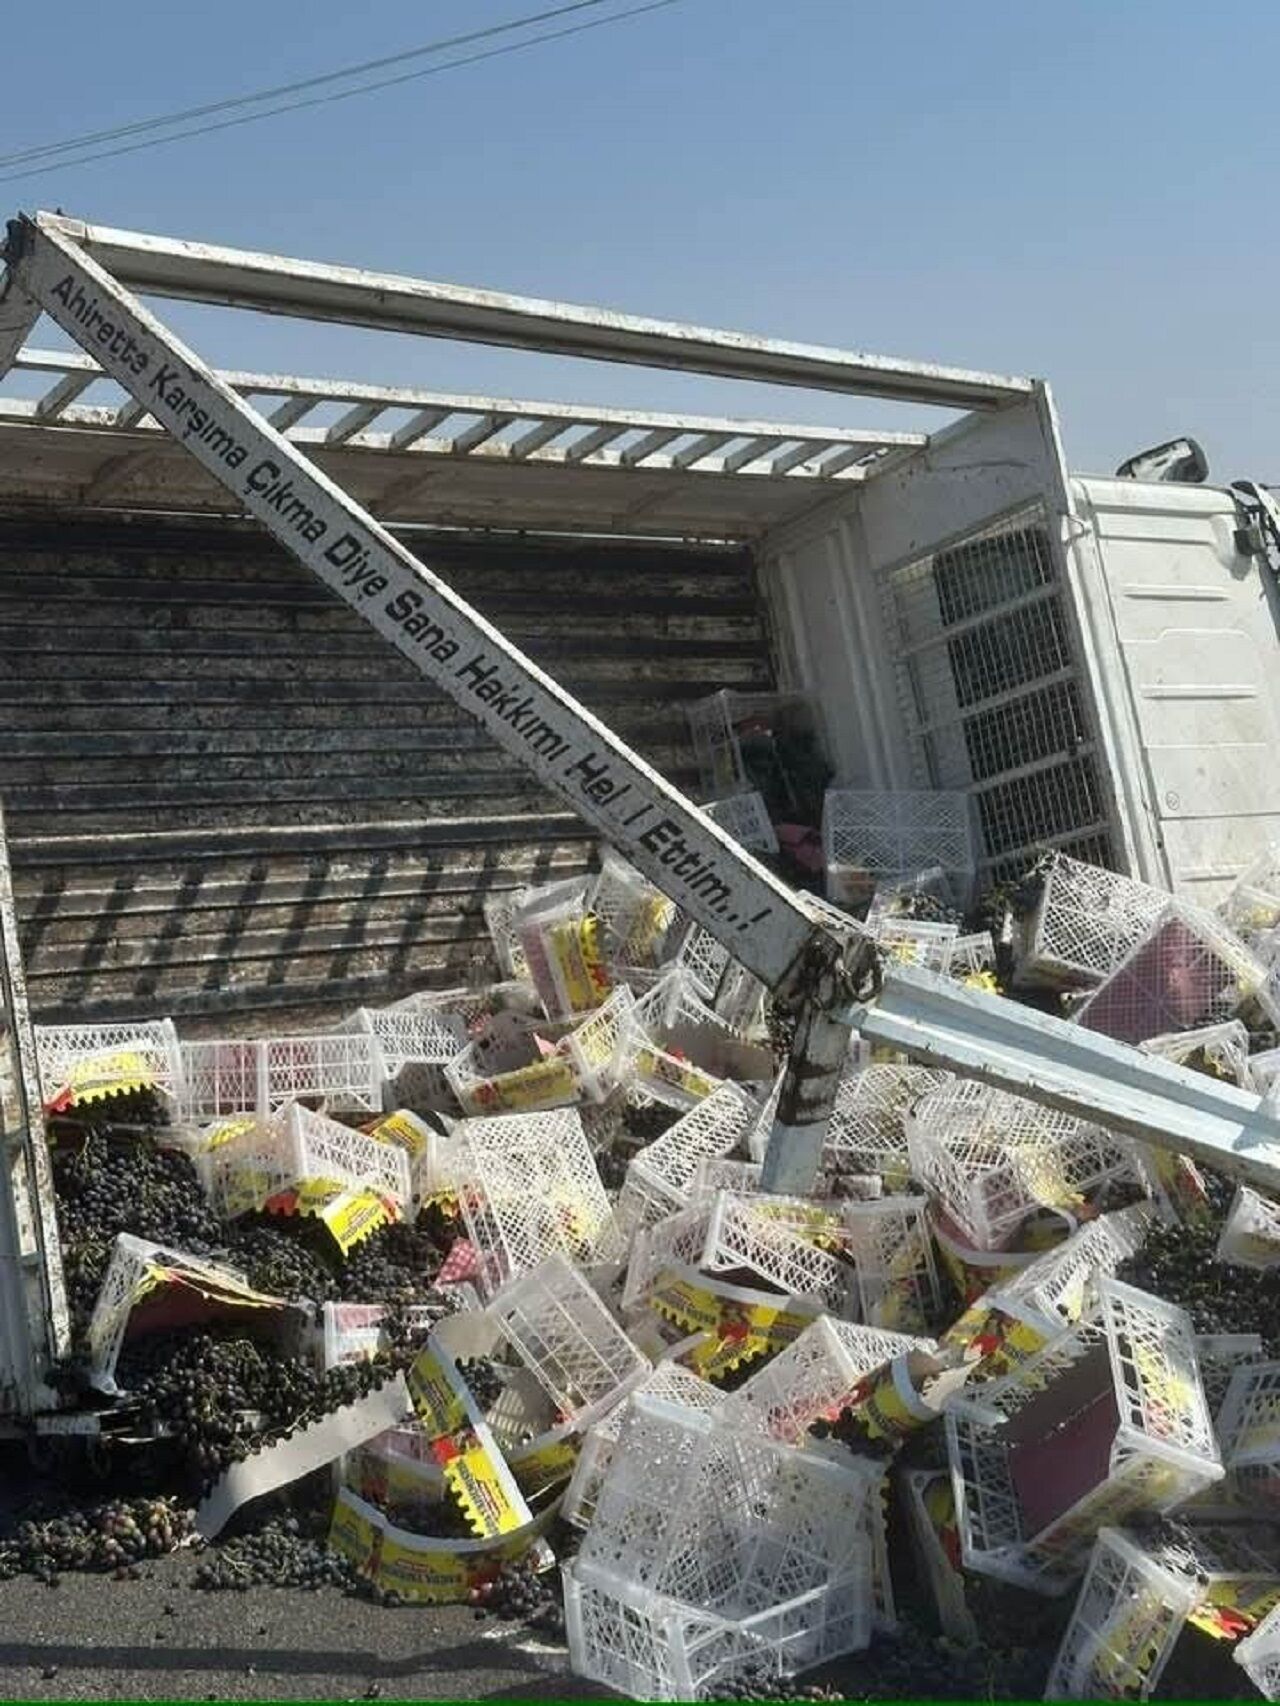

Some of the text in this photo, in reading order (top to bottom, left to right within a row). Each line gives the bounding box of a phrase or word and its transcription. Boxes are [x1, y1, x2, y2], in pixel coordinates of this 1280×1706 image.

[149, 363, 248, 470] Karşıma
[242, 459, 328, 544] Çıkma
[323, 532, 389, 597] Diye
[384, 589, 461, 663] Sana
[454, 653, 572, 762] Hakkımı
[563, 751, 654, 826] Hell
